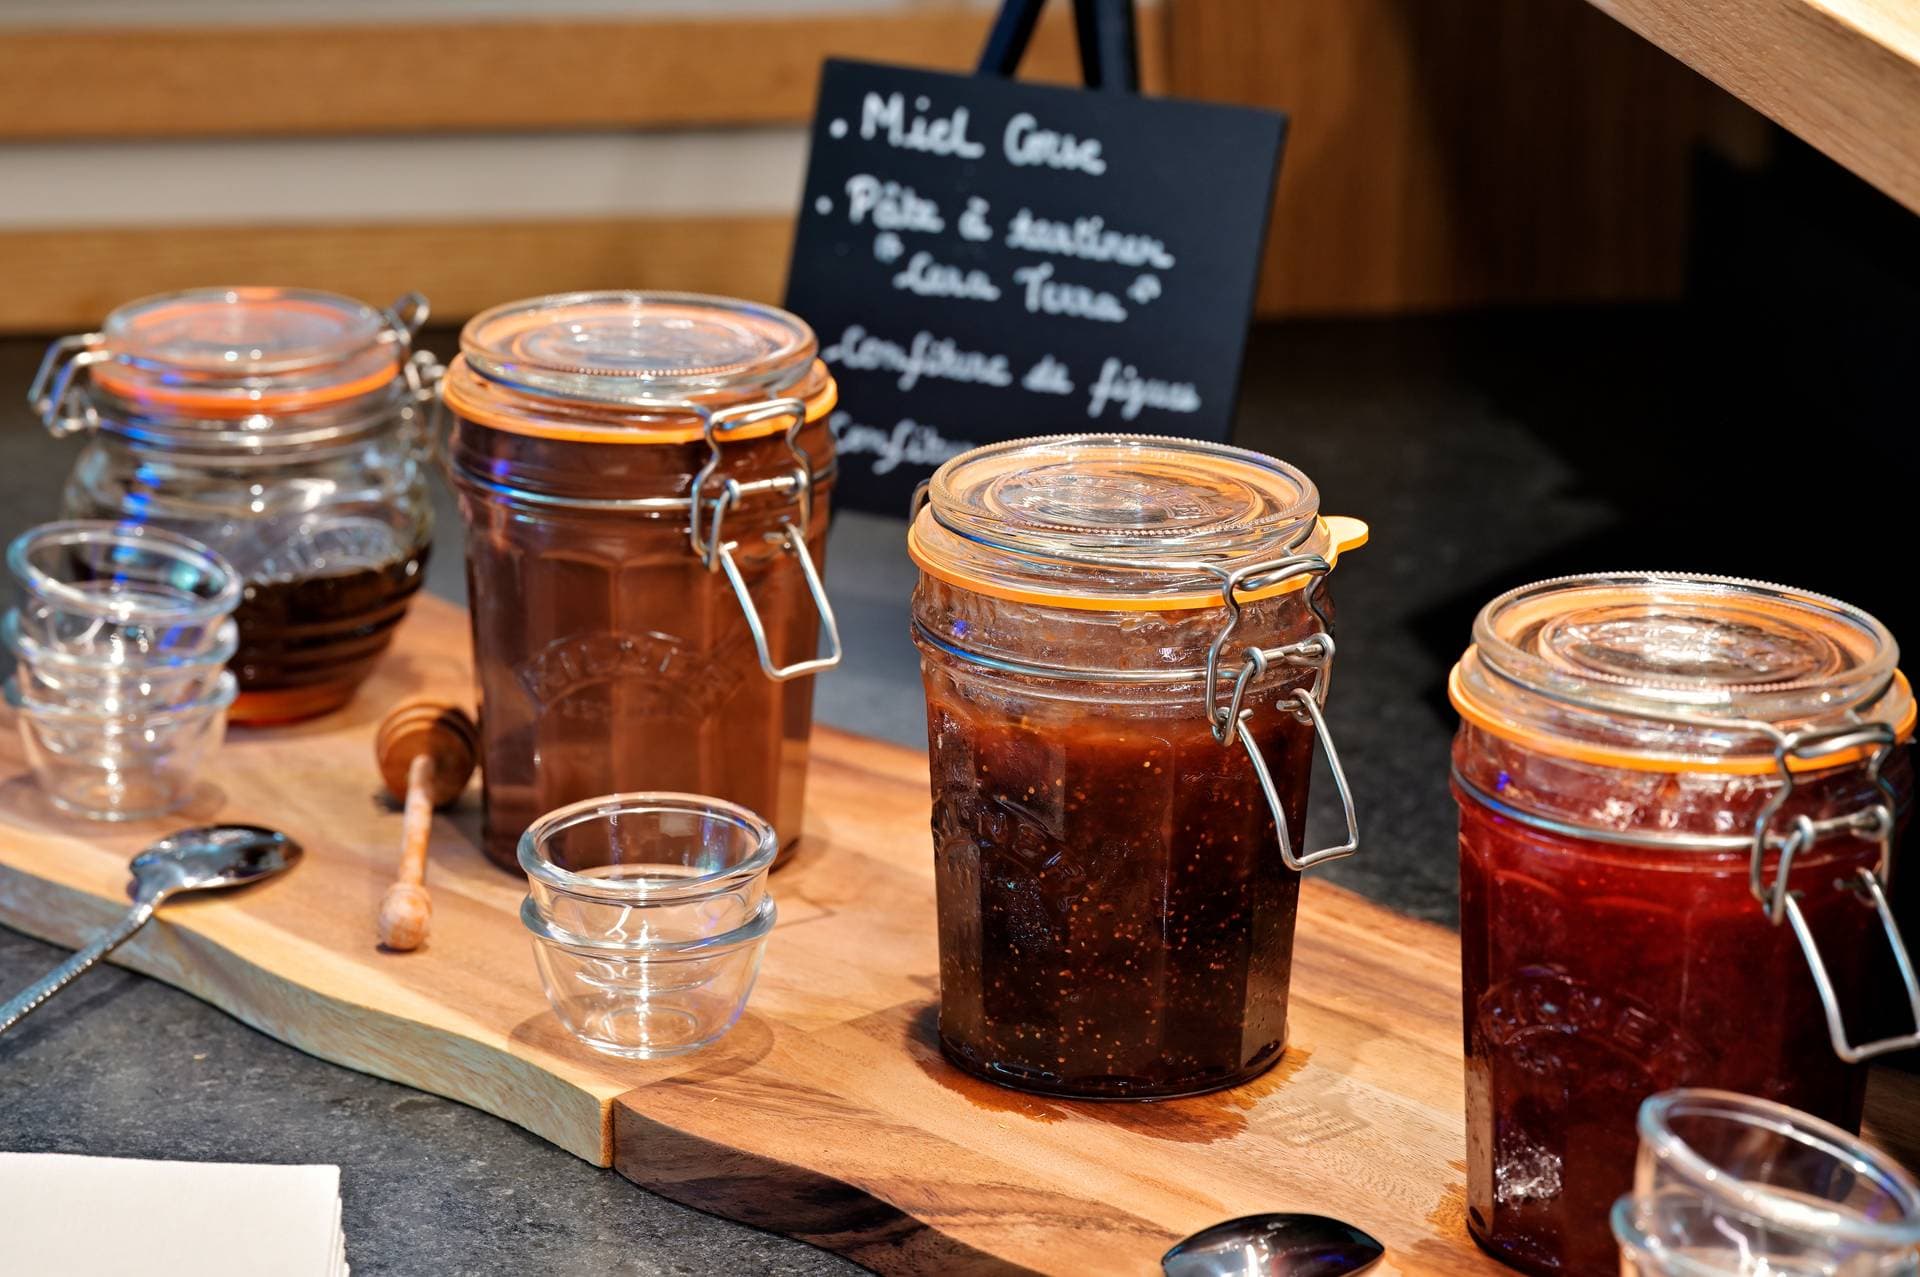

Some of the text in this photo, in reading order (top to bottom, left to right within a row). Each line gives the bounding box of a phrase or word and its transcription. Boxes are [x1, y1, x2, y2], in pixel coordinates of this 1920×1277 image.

[861, 92, 1107, 176] Miel Corse
[823, 325, 1012, 392] Confiture
[1023, 356, 1074, 395] de
